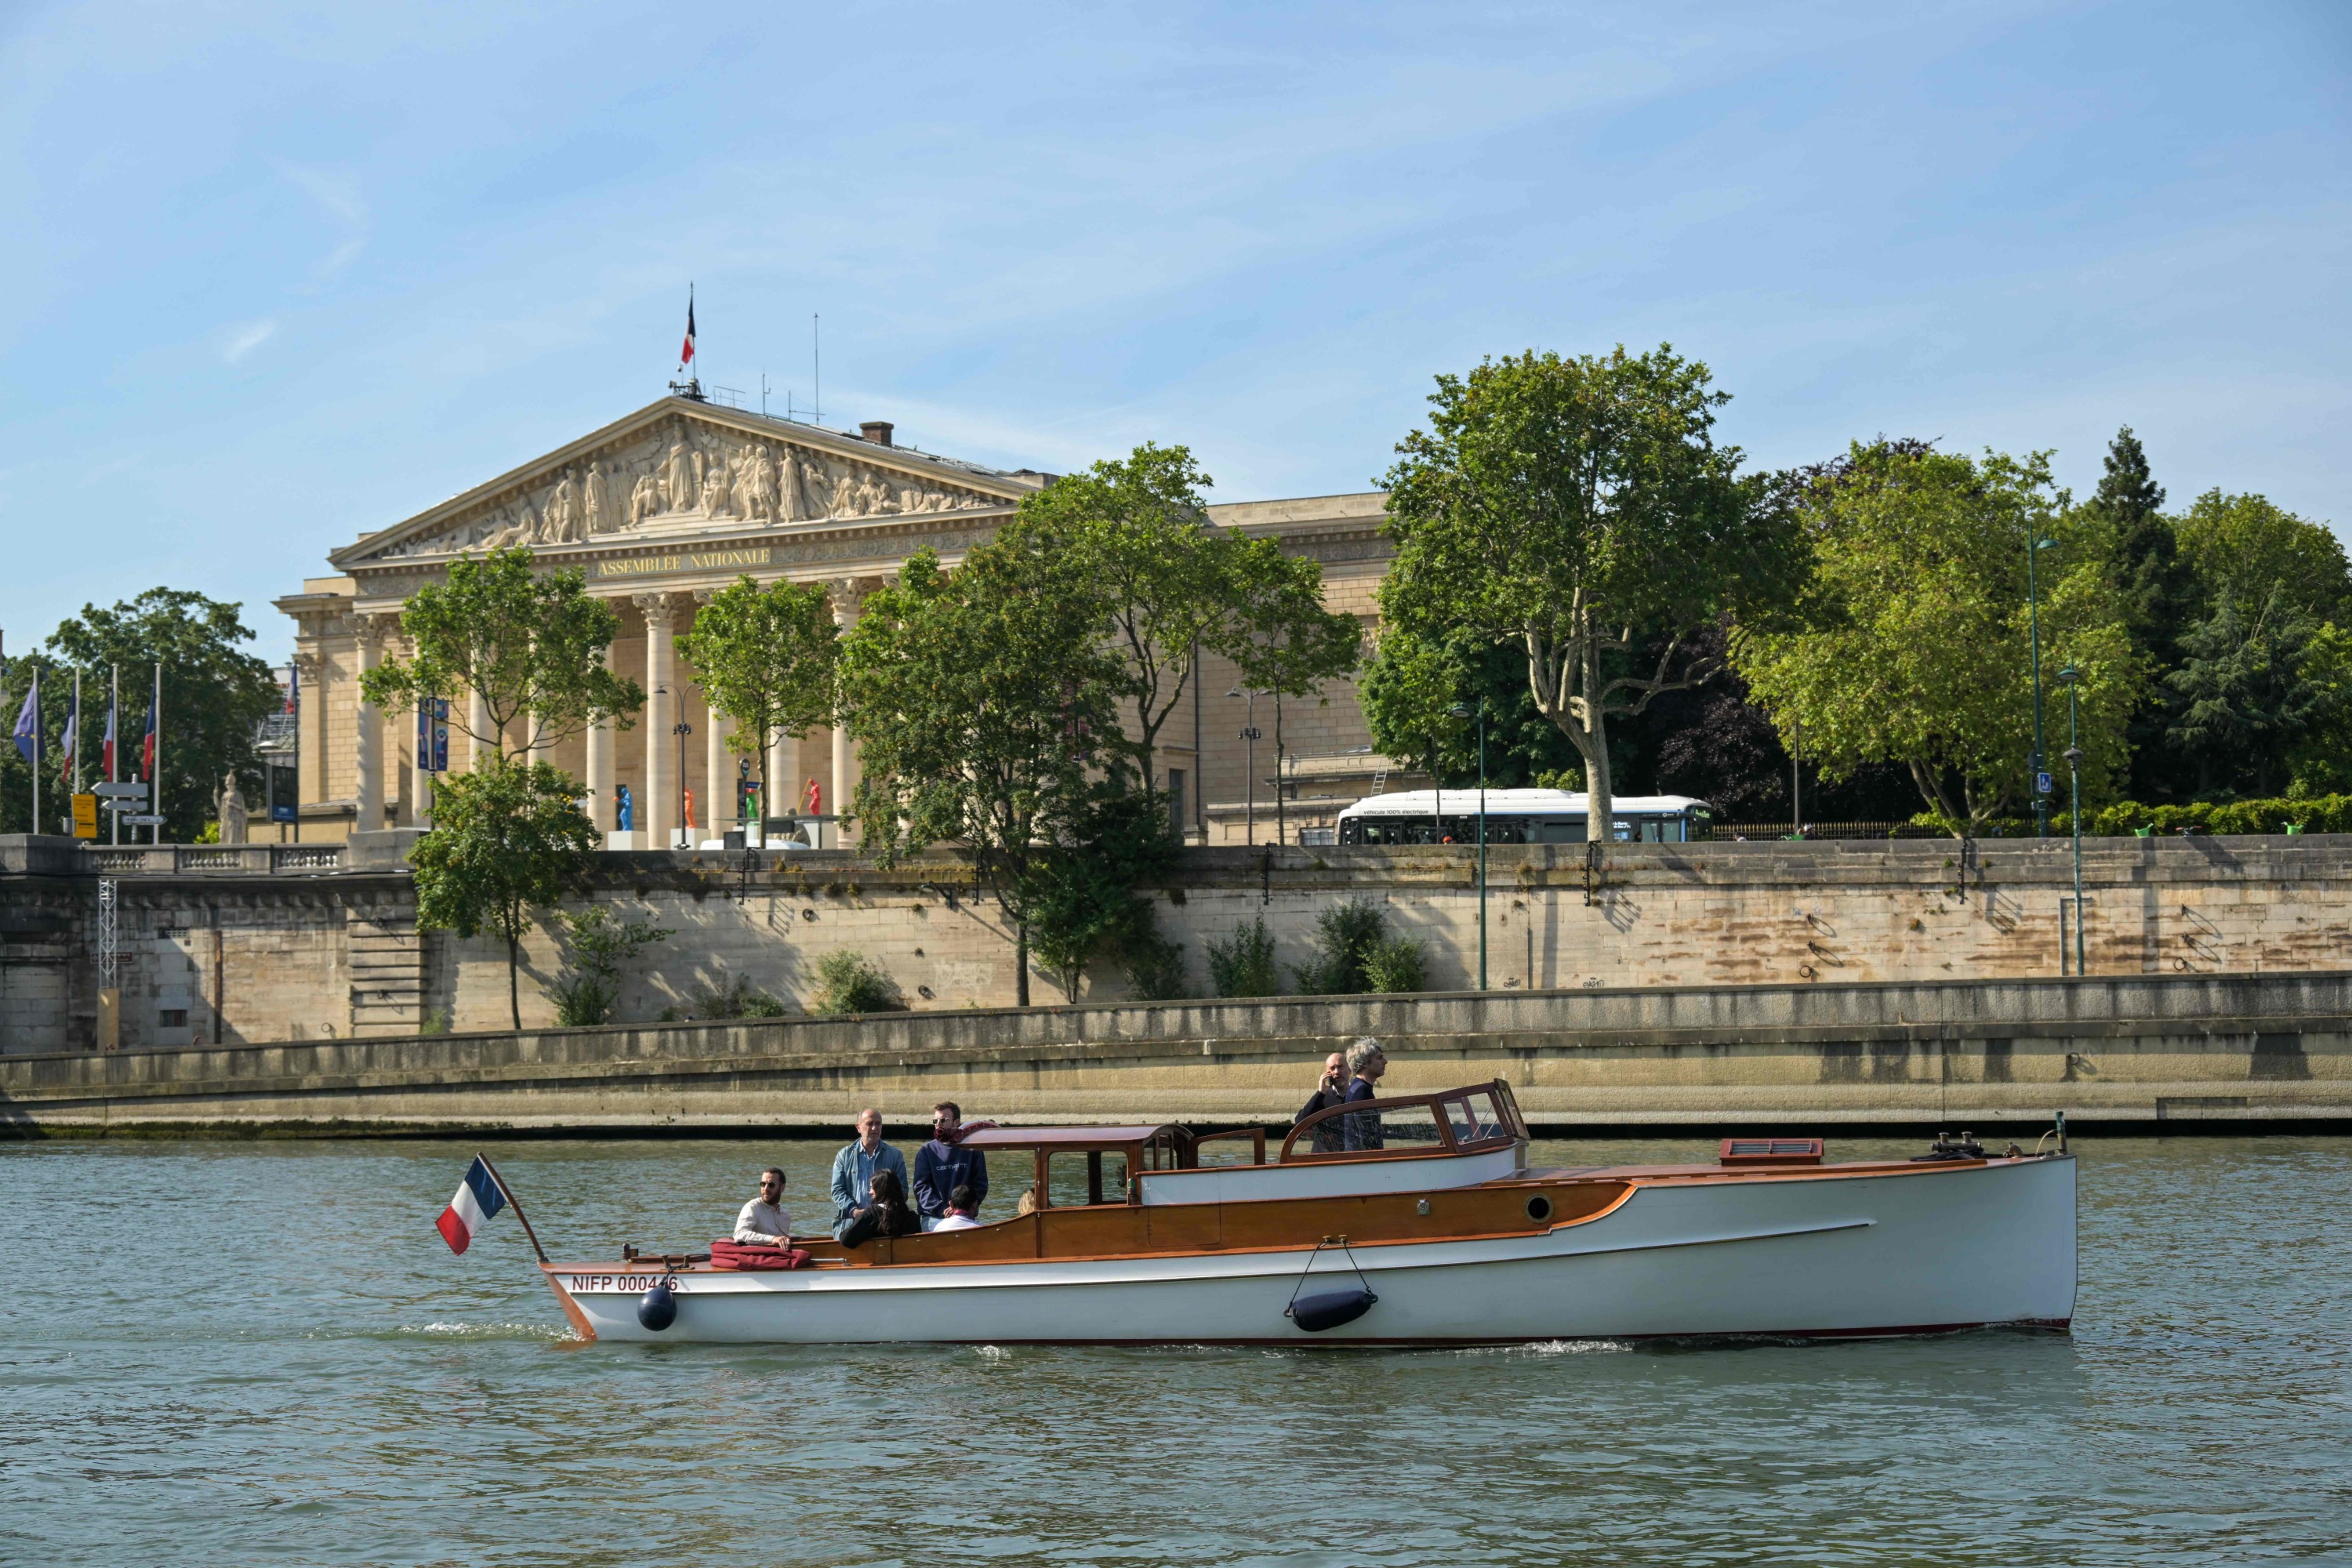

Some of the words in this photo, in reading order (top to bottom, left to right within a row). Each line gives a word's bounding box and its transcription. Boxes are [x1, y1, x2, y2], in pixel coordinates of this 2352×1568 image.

[598, 555, 681, 575] ASSEMBLÉE
[691, 549, 770, 569] NATIONALE
[572, 1276, 612, 1290] NIFP
